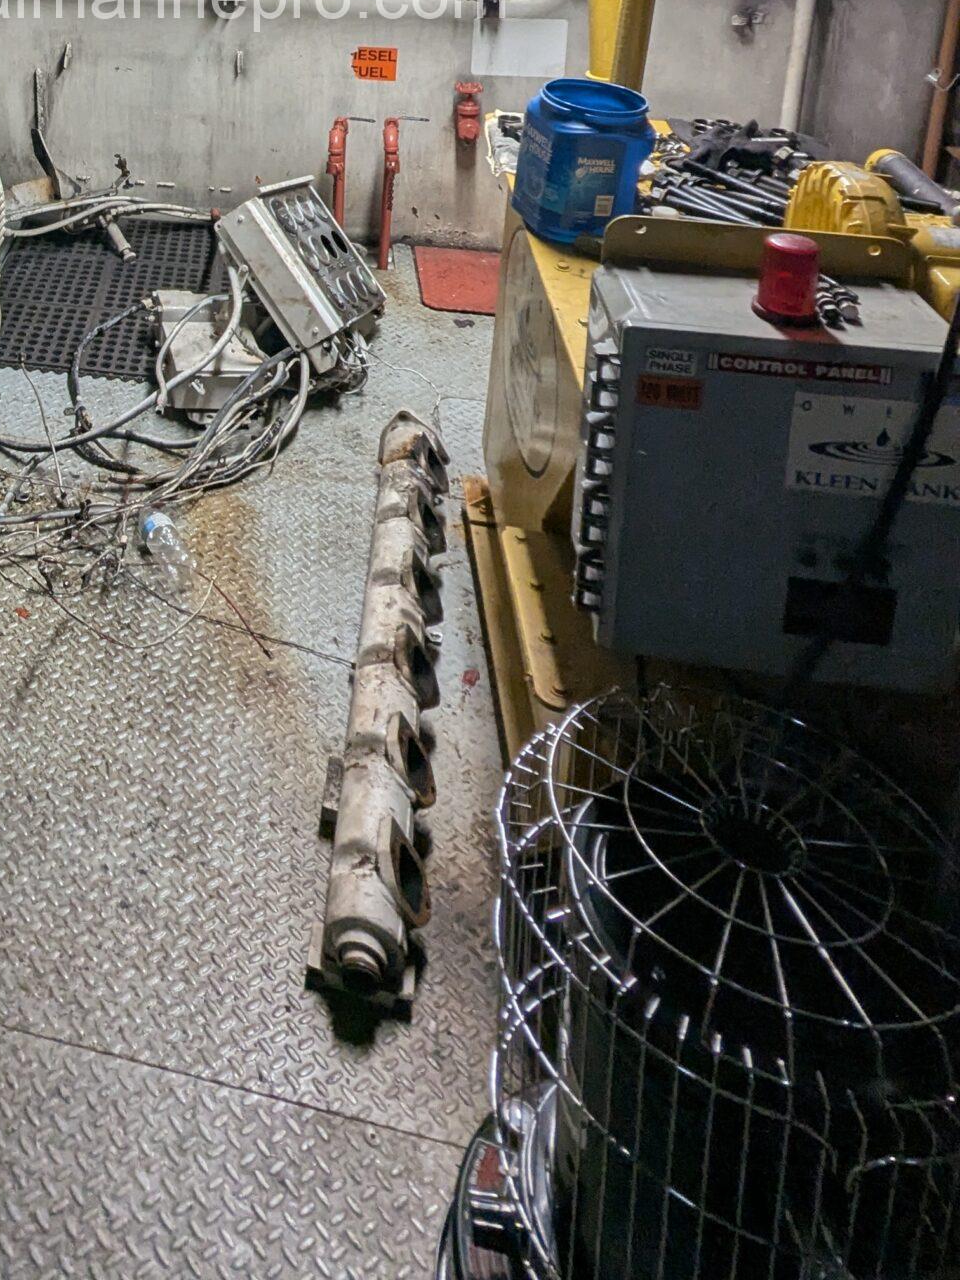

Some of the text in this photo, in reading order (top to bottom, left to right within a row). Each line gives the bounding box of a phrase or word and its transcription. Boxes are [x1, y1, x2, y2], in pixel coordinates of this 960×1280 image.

[648, 350, 694, 363] SINGLE
[649, 361, 692, 375] PHASE
[720, 356, 881, 382] CONTROL PANEL
[795, 471, 879, 491] KLEEN
